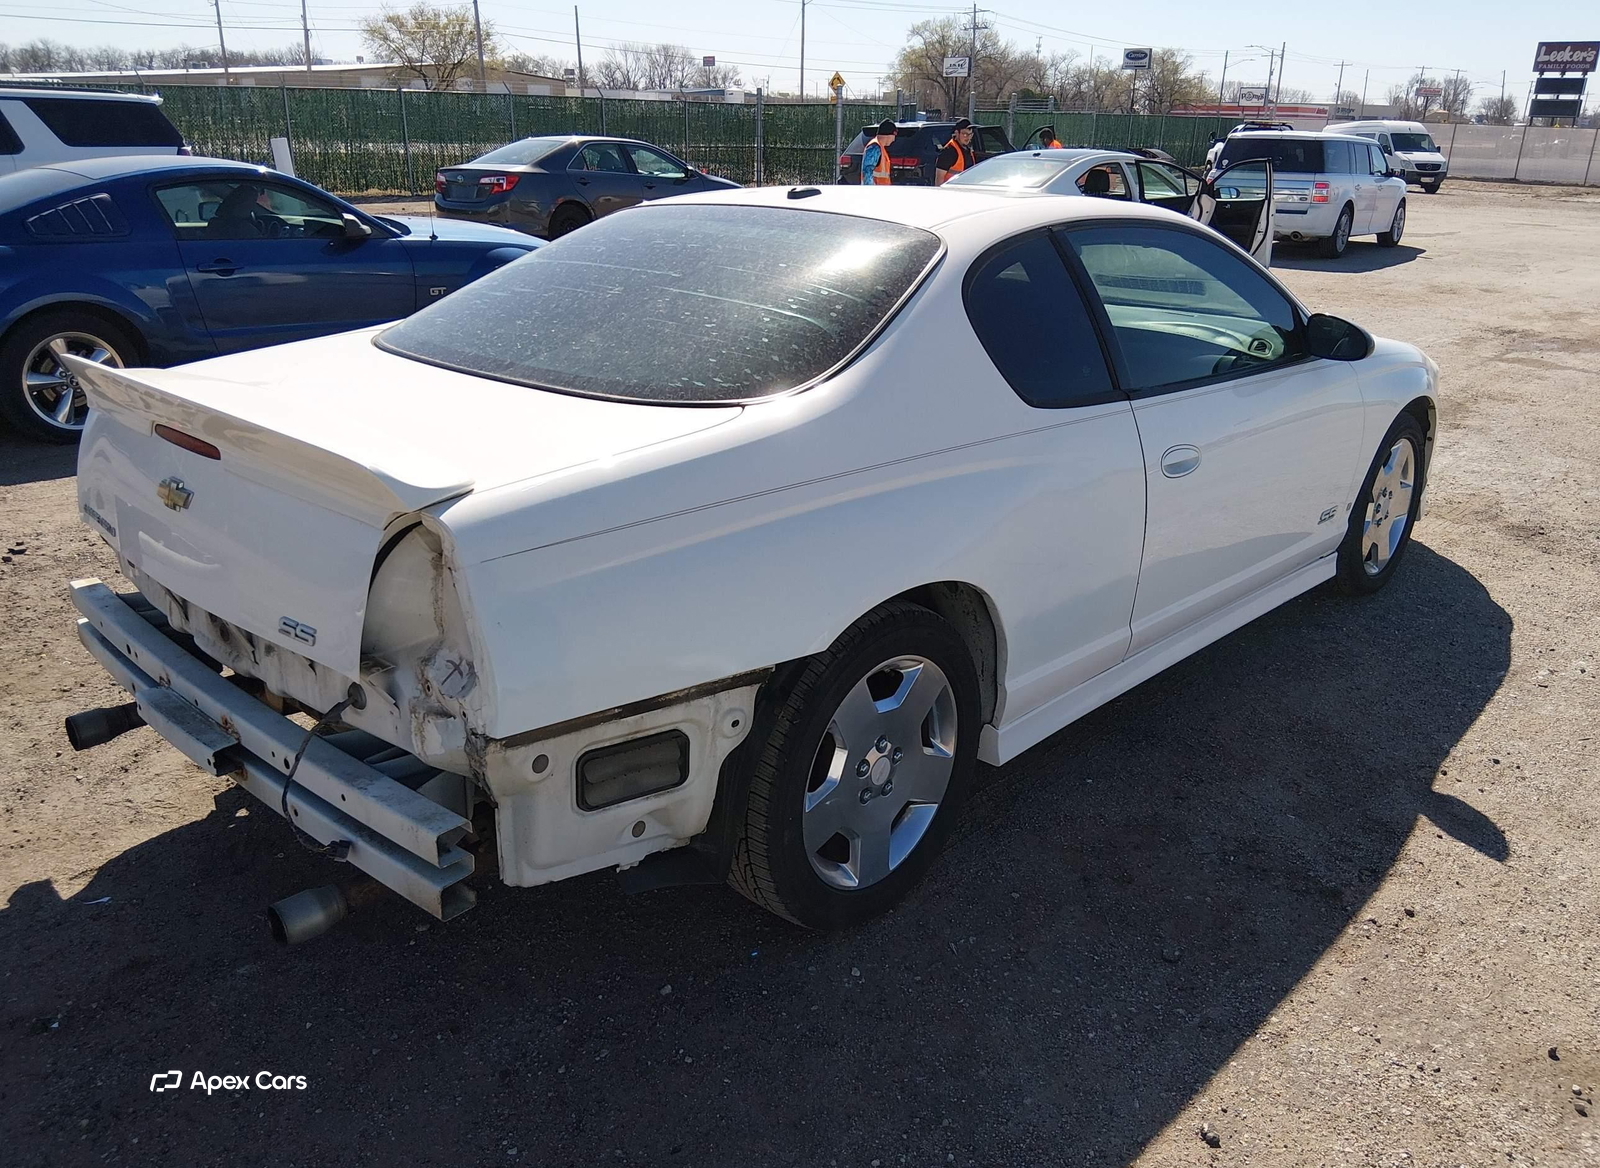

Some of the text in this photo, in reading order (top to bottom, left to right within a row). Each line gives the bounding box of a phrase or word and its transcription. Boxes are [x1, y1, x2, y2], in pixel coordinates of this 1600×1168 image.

[1537, 45, 1596, 62] Leeker's
[430, 287, 447, 296] GT
[278, 615, 317, 647] SS
